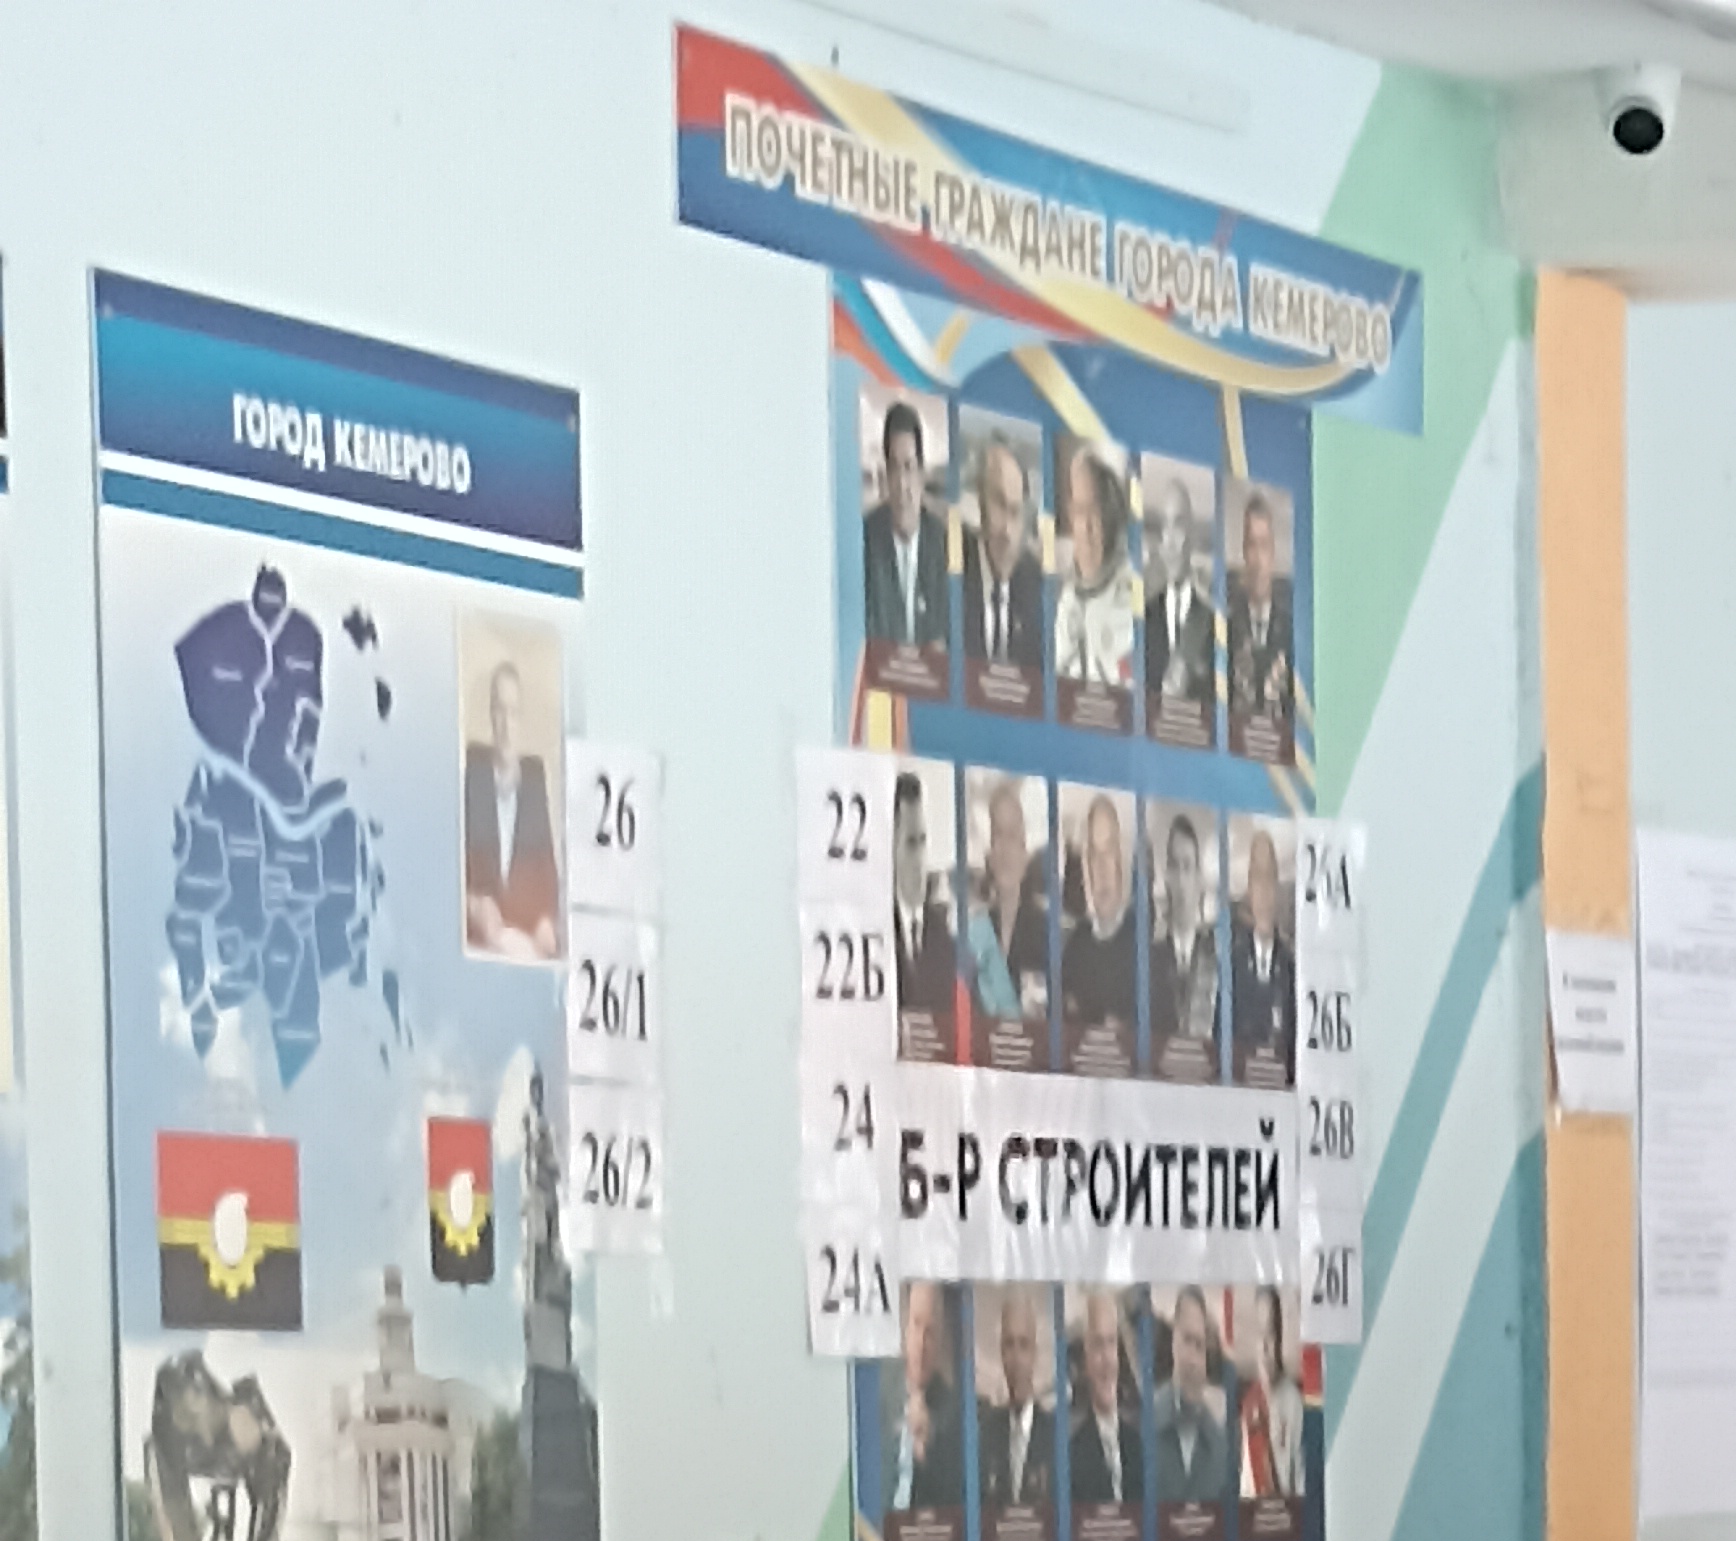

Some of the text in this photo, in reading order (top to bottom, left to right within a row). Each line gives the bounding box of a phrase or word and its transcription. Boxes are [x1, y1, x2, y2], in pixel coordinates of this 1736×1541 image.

[727, 98, 1390, 370] ПОЧЕТНЫЕ ГРАЖДАНЕ ГОРОДА КЕМЕРОВО
[233, 393, 471, 494] ГОРОД КЕМЕРОВО
[596, 771, 635, 851] 26
[826, 789, 868, 861] 22
[580, 957, 648, 1041] 26/1
[814, 930, 885, 1000] 22Б
[1307, 990, 1353, 1053] 26Б
[832, 1081, 874, 1152] 24
[1309, 1095, 1355, 1159] 26В
[583, 1131, 653, 1209] 26/2
[900, 1117, 1280, 1231] Б-Р СТРОИТЕЛЕЙ
[819, 1244, 892, 1314] 24А
[1311, 1246, 1356, 1308] 26Г
